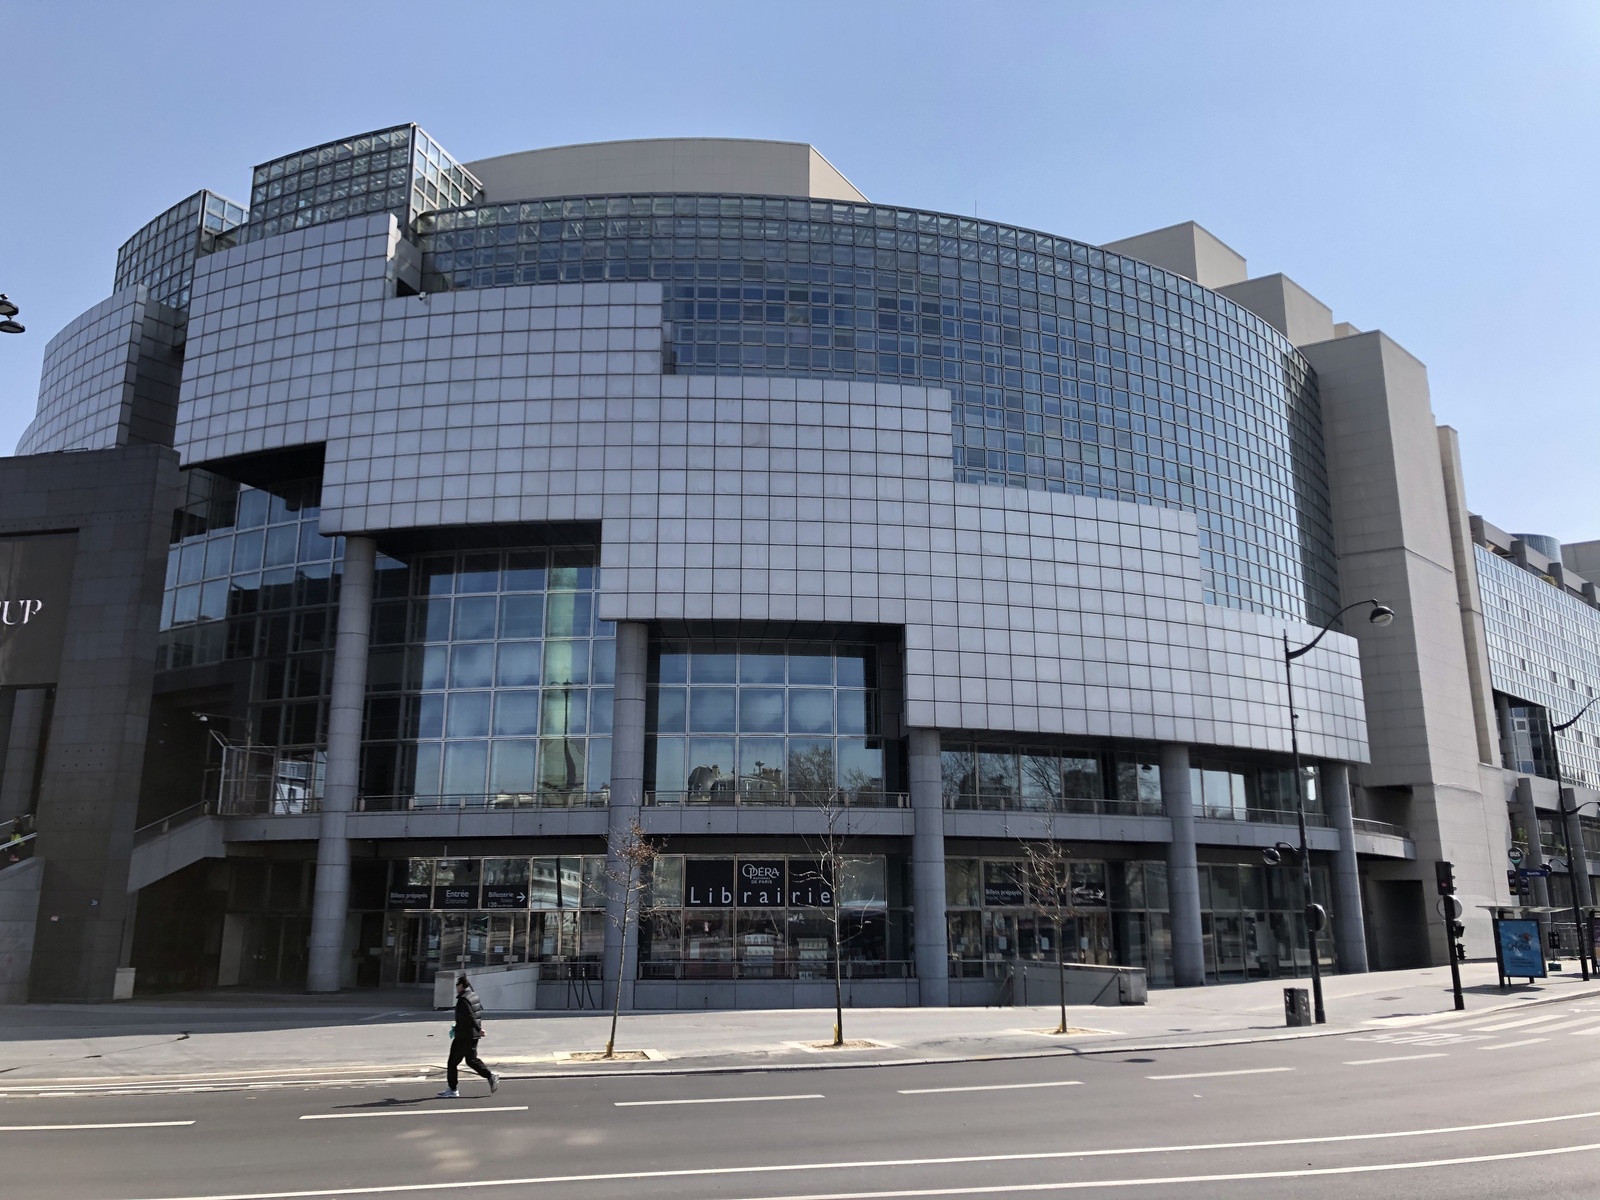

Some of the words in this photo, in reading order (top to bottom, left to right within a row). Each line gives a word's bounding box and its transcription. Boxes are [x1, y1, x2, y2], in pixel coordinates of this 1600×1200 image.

[0, 599, 43, 625] UP
[445, 889, 470, 898] Entrée
[690, 886, 831, 904] Librairie
